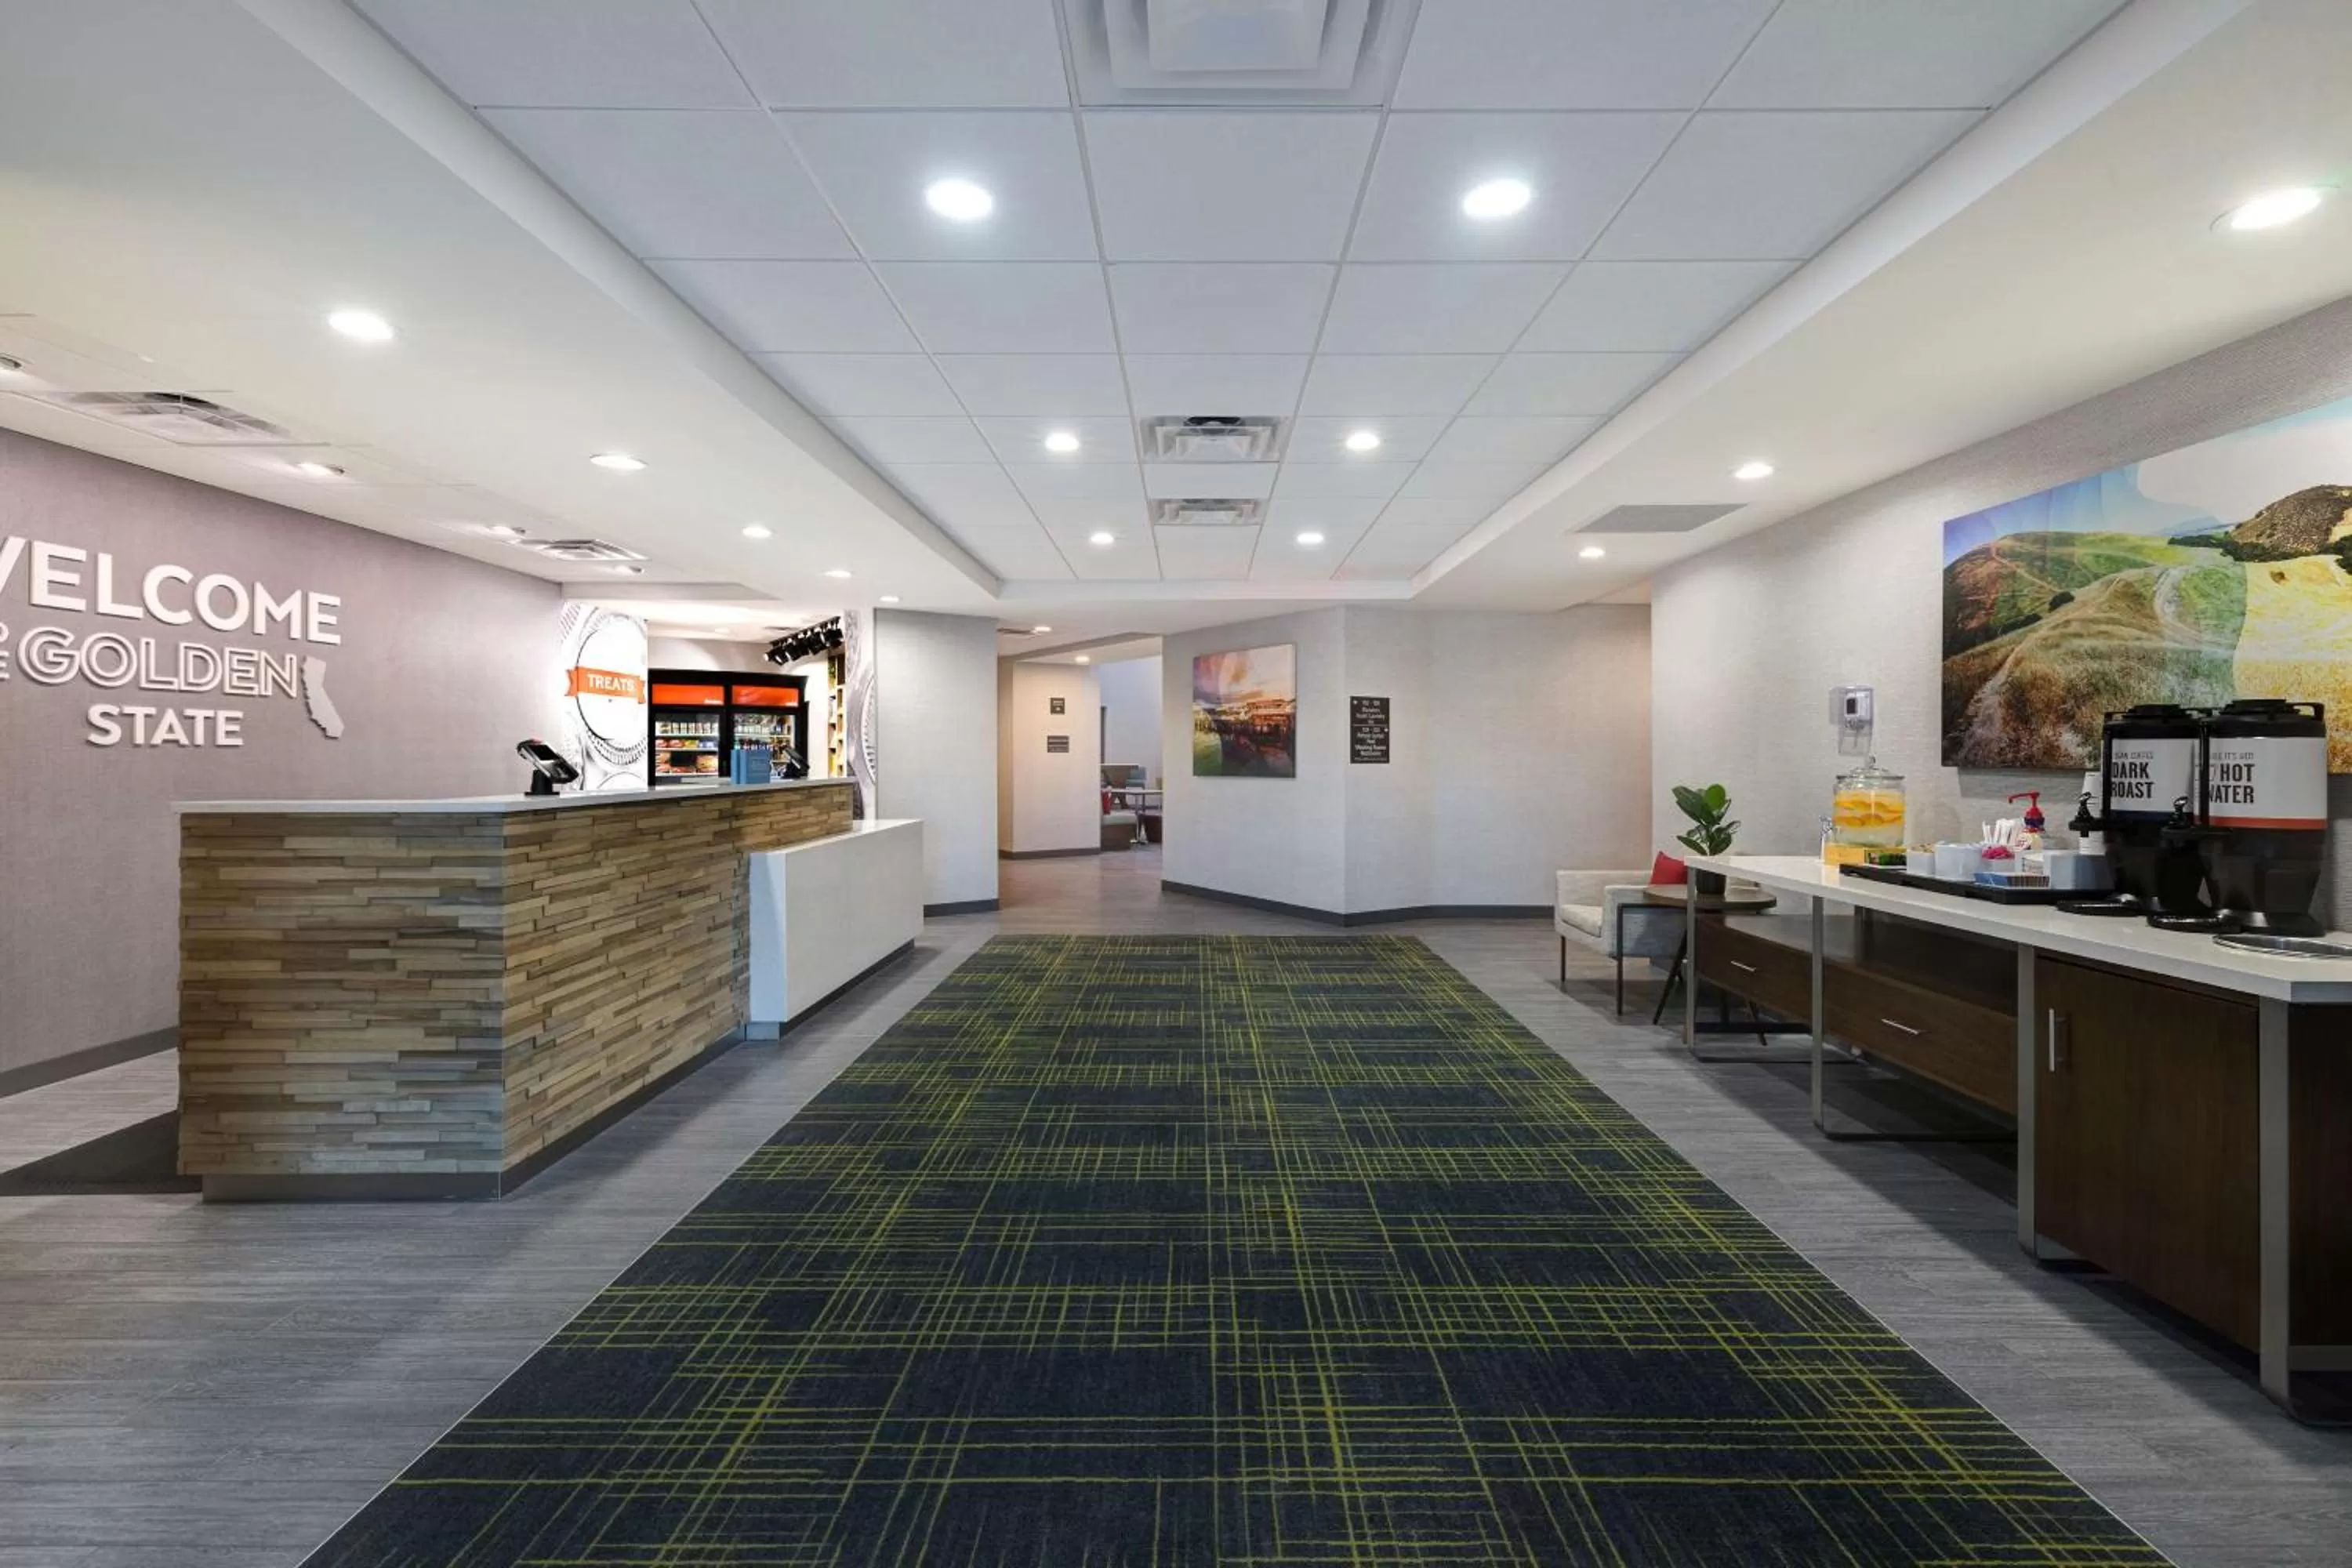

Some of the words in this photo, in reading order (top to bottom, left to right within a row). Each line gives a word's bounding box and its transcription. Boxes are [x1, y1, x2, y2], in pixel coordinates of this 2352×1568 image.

[16, 626, 298, 699] GOLDEN
[586, 673, 635, 691] TREATS
[86, 703, 245, 746] STATE
[2111, 761, 2149, 779] DARK
[2220, 763, 2255, 782] HOT
